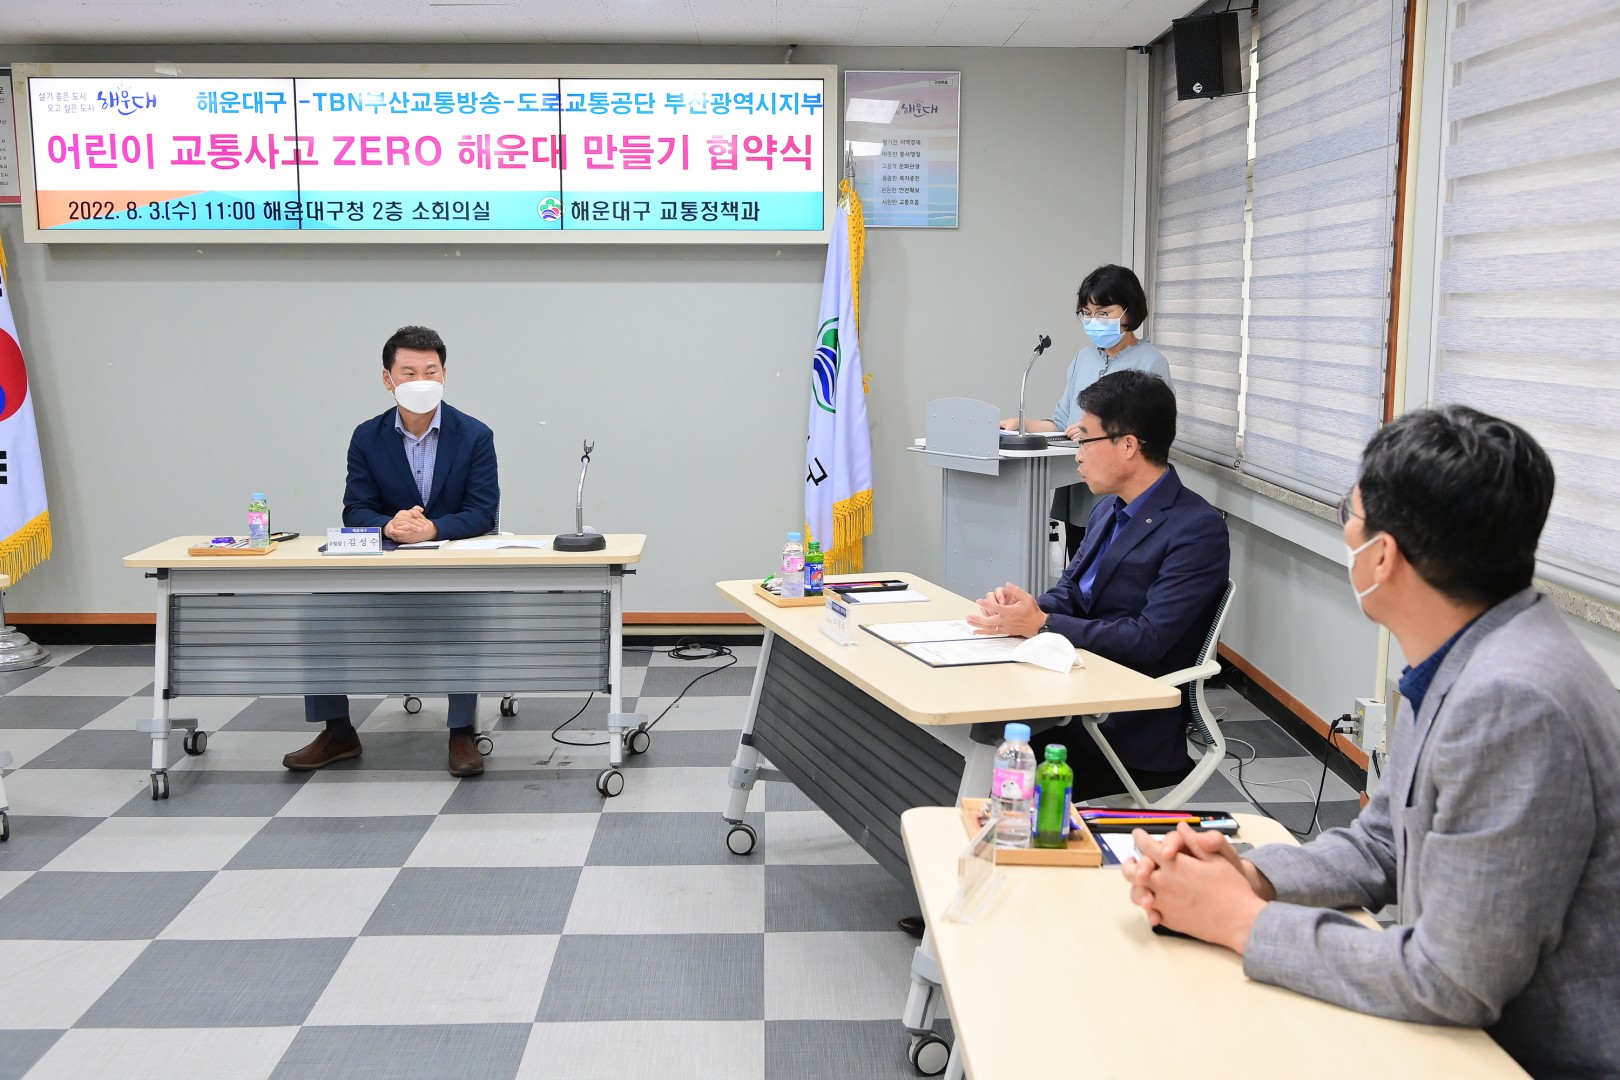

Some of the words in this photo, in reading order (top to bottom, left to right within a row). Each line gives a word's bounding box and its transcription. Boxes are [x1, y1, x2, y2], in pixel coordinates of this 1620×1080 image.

[38, 92, 53, 102] 살기
[55, 92, 69, 102] 좋은
[72, 92, 87, 101] 도시
[97, 90, 157, 116] 해운대
[197, 91, 287, 114] 해운대구
[664, 92, 823, 115] 부산광역시지부
[47, 104, 61, 112] 오고
[63, 103, 78, 113] 싶은
[80, 104, 95, 112] 도시
[901, 103, 938, 118] 해운대
[48, 134, 154, 169] 어린이
[171, 134, 318, 170] 교통사고
[333, 136, 442, 166] ZERO
[458, 134, 567, 170] 해운대
[584, 135, 688, 170] 만들기
[707, 135, 812, 170] 협약식
[69, 202, 119, 220] 2022.
[127, 202, 142, 220] 8.
[205, 202, 255, 220] 11:00
[263, 201, 364, 222] 해운대구청
[373, 202, 403, 221] 2층
[412, 202, 490, 221] 소회의실
[571, 202, 650, 221] 해운대구
[660, 202, 760, 222] 교통정책과
